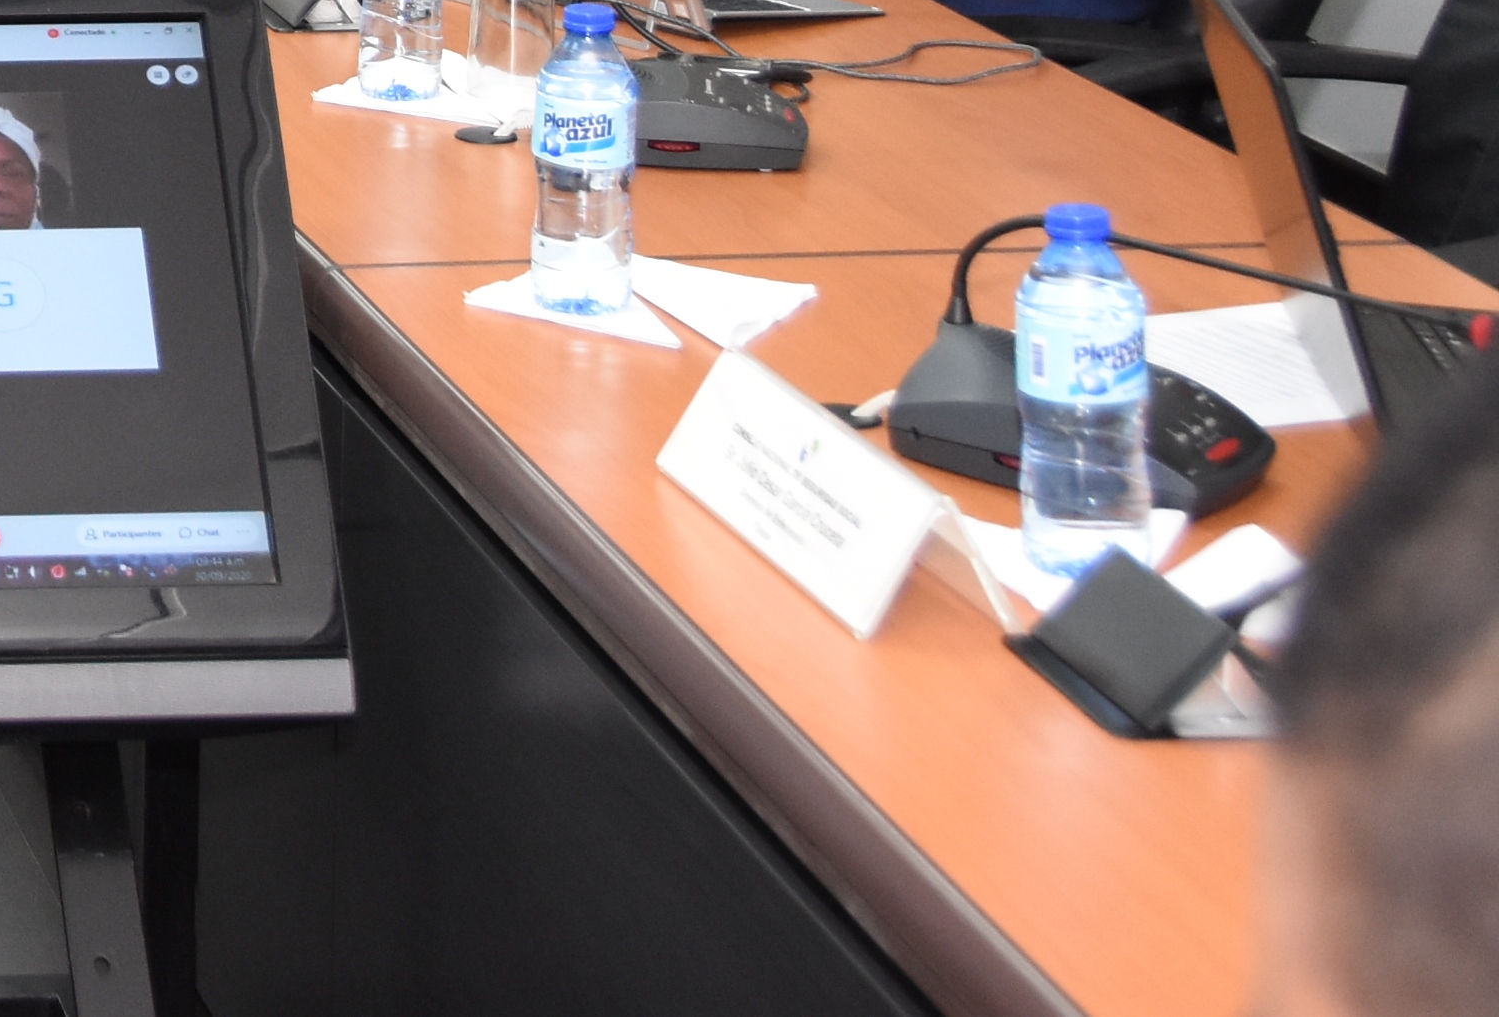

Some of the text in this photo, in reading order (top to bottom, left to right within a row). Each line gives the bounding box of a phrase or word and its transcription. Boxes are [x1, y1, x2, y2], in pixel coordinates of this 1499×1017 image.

[64, 28, 106, 36] Conectado
[544, 112, 607, 129] Planeta
[566, 117, 613, 141] azul
[103, 528, 162, 539] Participantes
[197, 527, 220, 537] Chat
